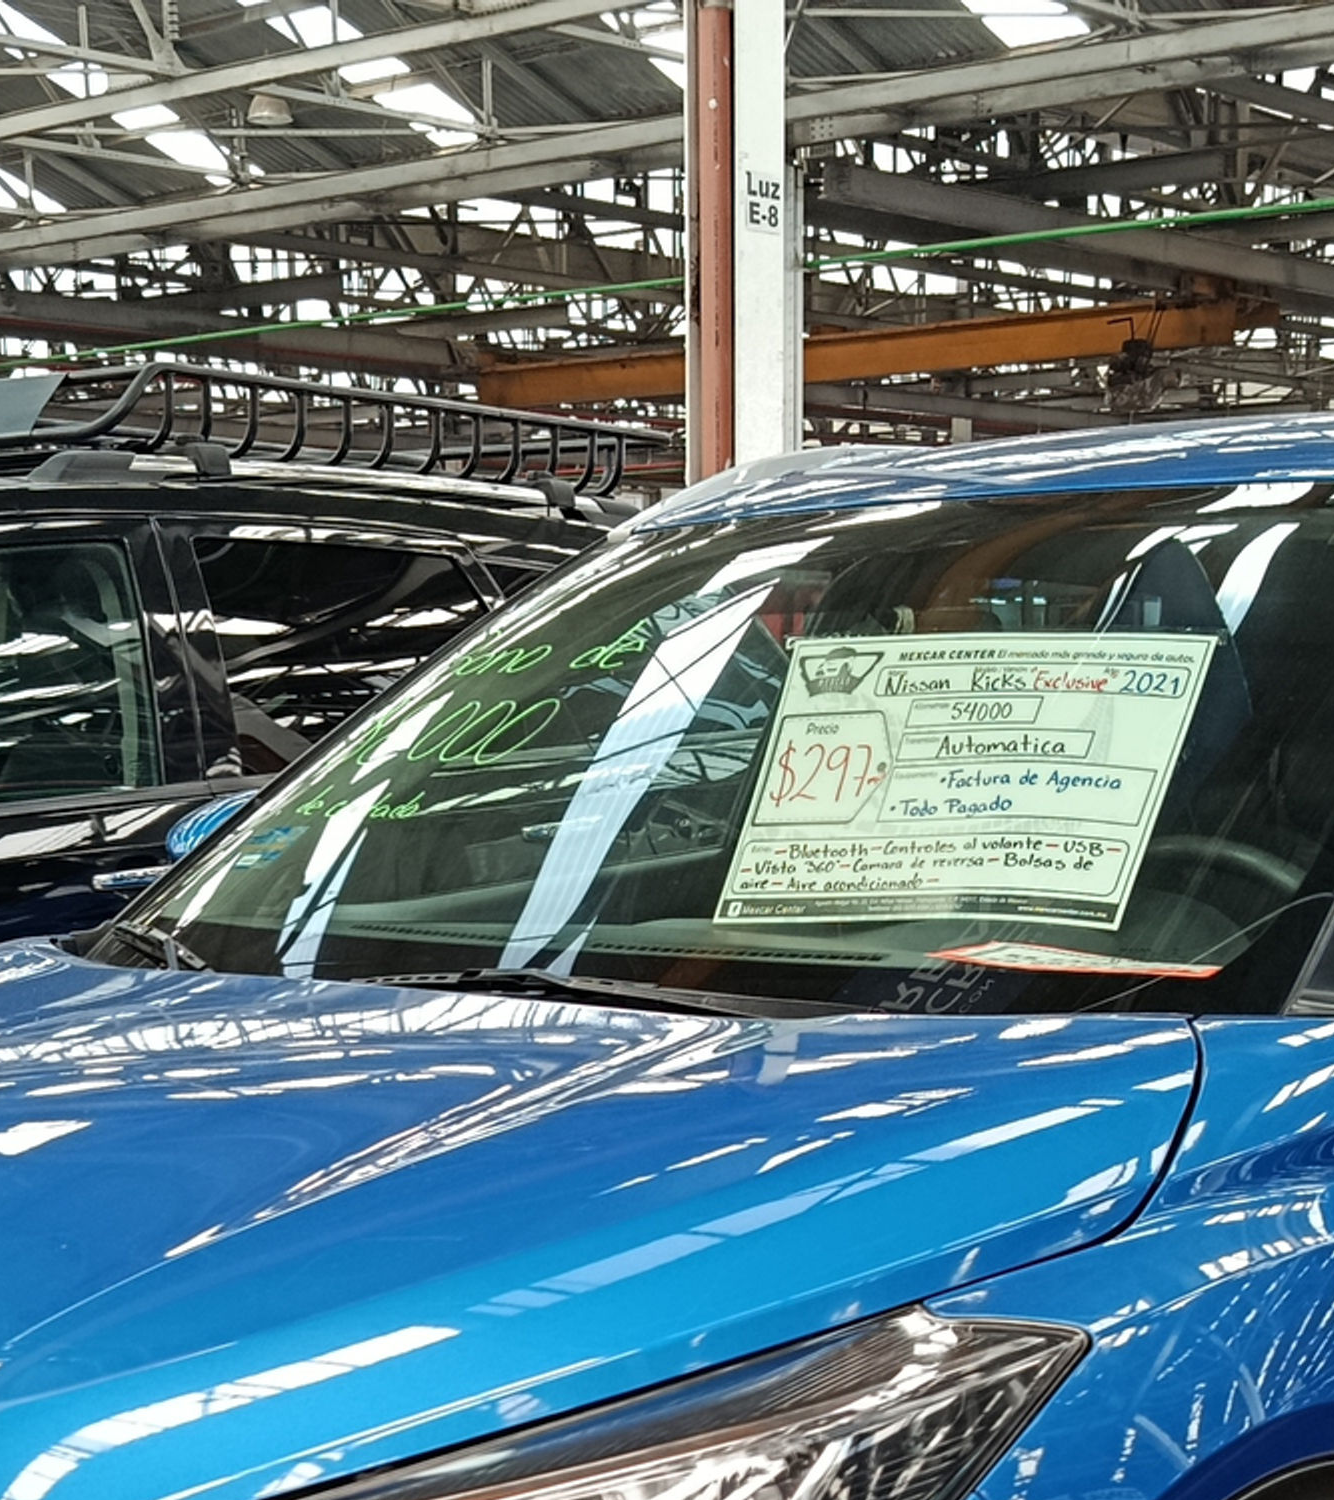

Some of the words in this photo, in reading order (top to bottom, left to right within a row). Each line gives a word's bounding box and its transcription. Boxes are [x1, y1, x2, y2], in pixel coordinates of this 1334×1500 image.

[746, 171, 780, 200] Luz
[749, 202, 779, 227] E-8
[898, 650, 946, 662] MEXCAR
[948, 649, 996, 660] CENTER
[884, 671, 951, 696] Nissan
[971, 667, 1027, 692] Kicks
[1120, 669, 1180, 695] 2021
[950, 701, 1013, 721] 54000
[805, 721, 840, 736] Precio
[935, 734, 1066, 759] Automatica
[1018, 767, 1038, 786] de
[1046, 769, 1122, 793] Agencia
[943, 794, 1013, 818] Pagado
[963, 837, 978, 850] al
[982, 836, 1043, 851] volante
[1073, 855, 1094, 871] de
[774, 903, 807, 914] Center
